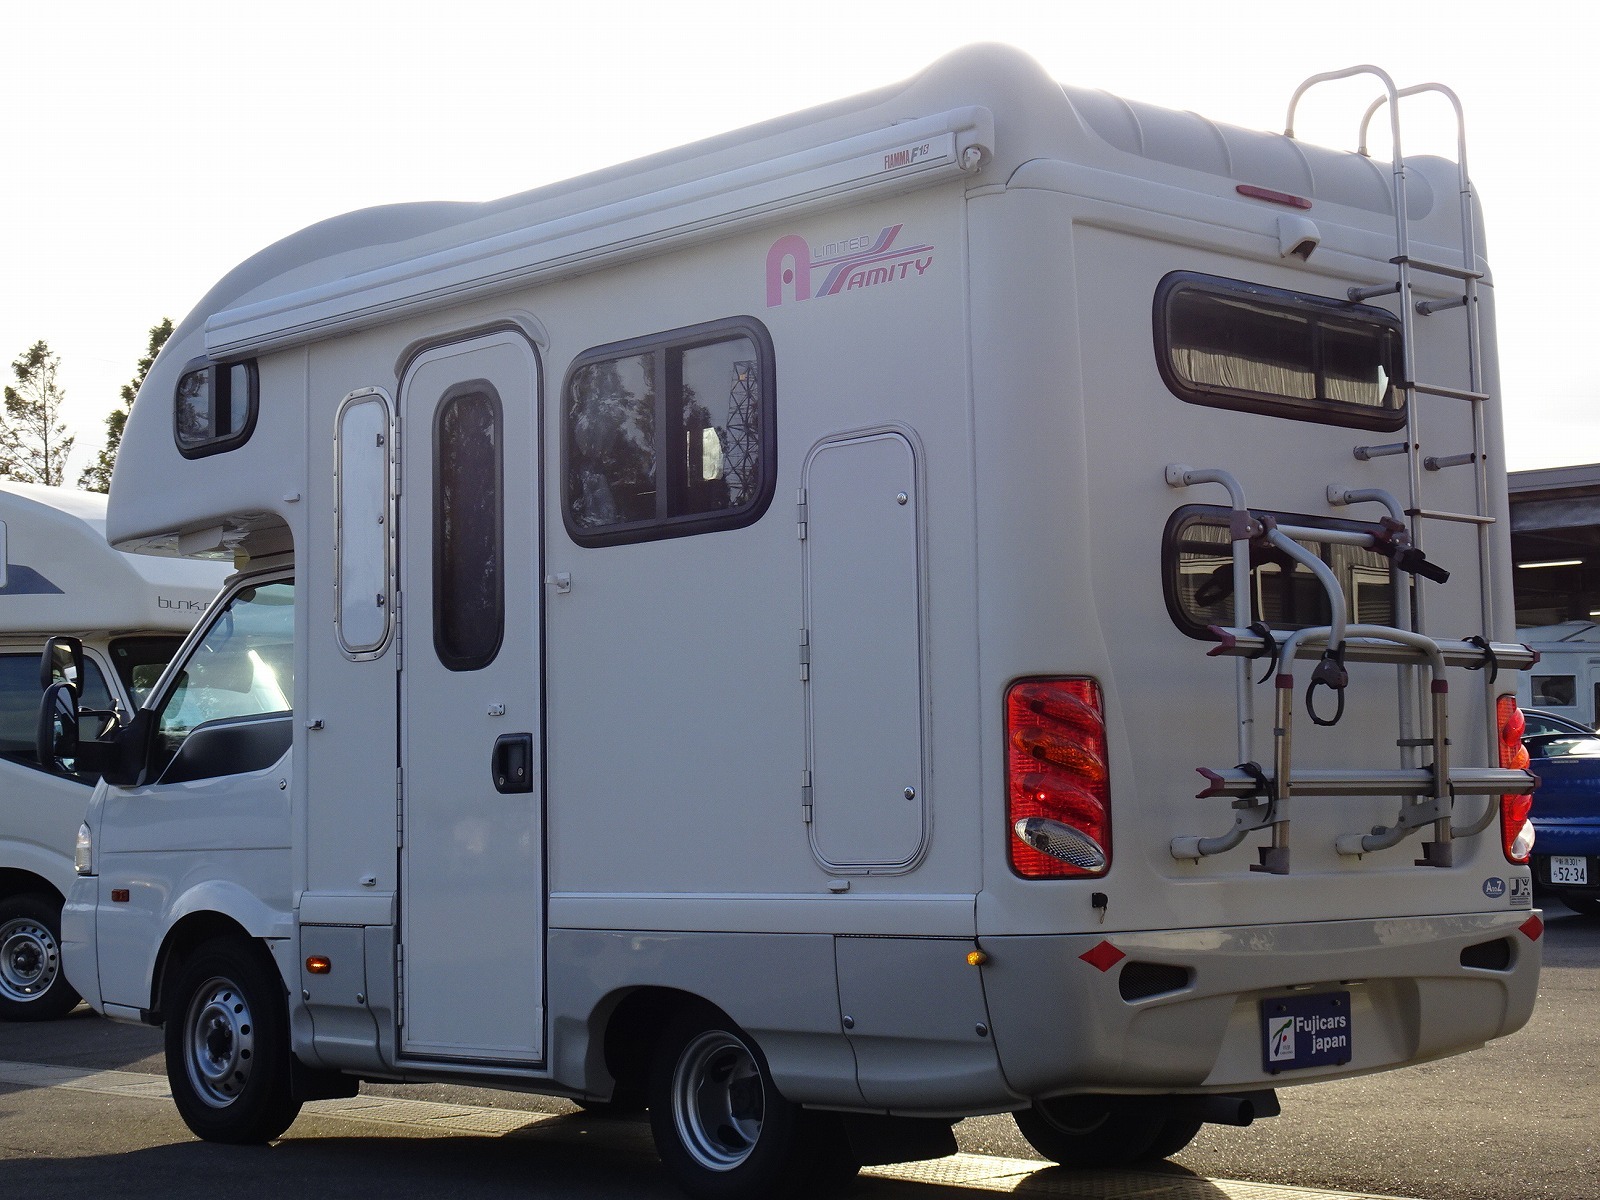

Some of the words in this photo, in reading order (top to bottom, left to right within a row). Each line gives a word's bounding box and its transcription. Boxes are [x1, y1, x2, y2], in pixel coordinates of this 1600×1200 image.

[884, 149, 910, 170] FIAMMA
[813, 235, 870, 258] LIMITED
[847, 256, 933, 291] AMITY
[1296, 1015, 1346, 1035] Fujicars
[1311, 1035, 1346, 1054] japan
